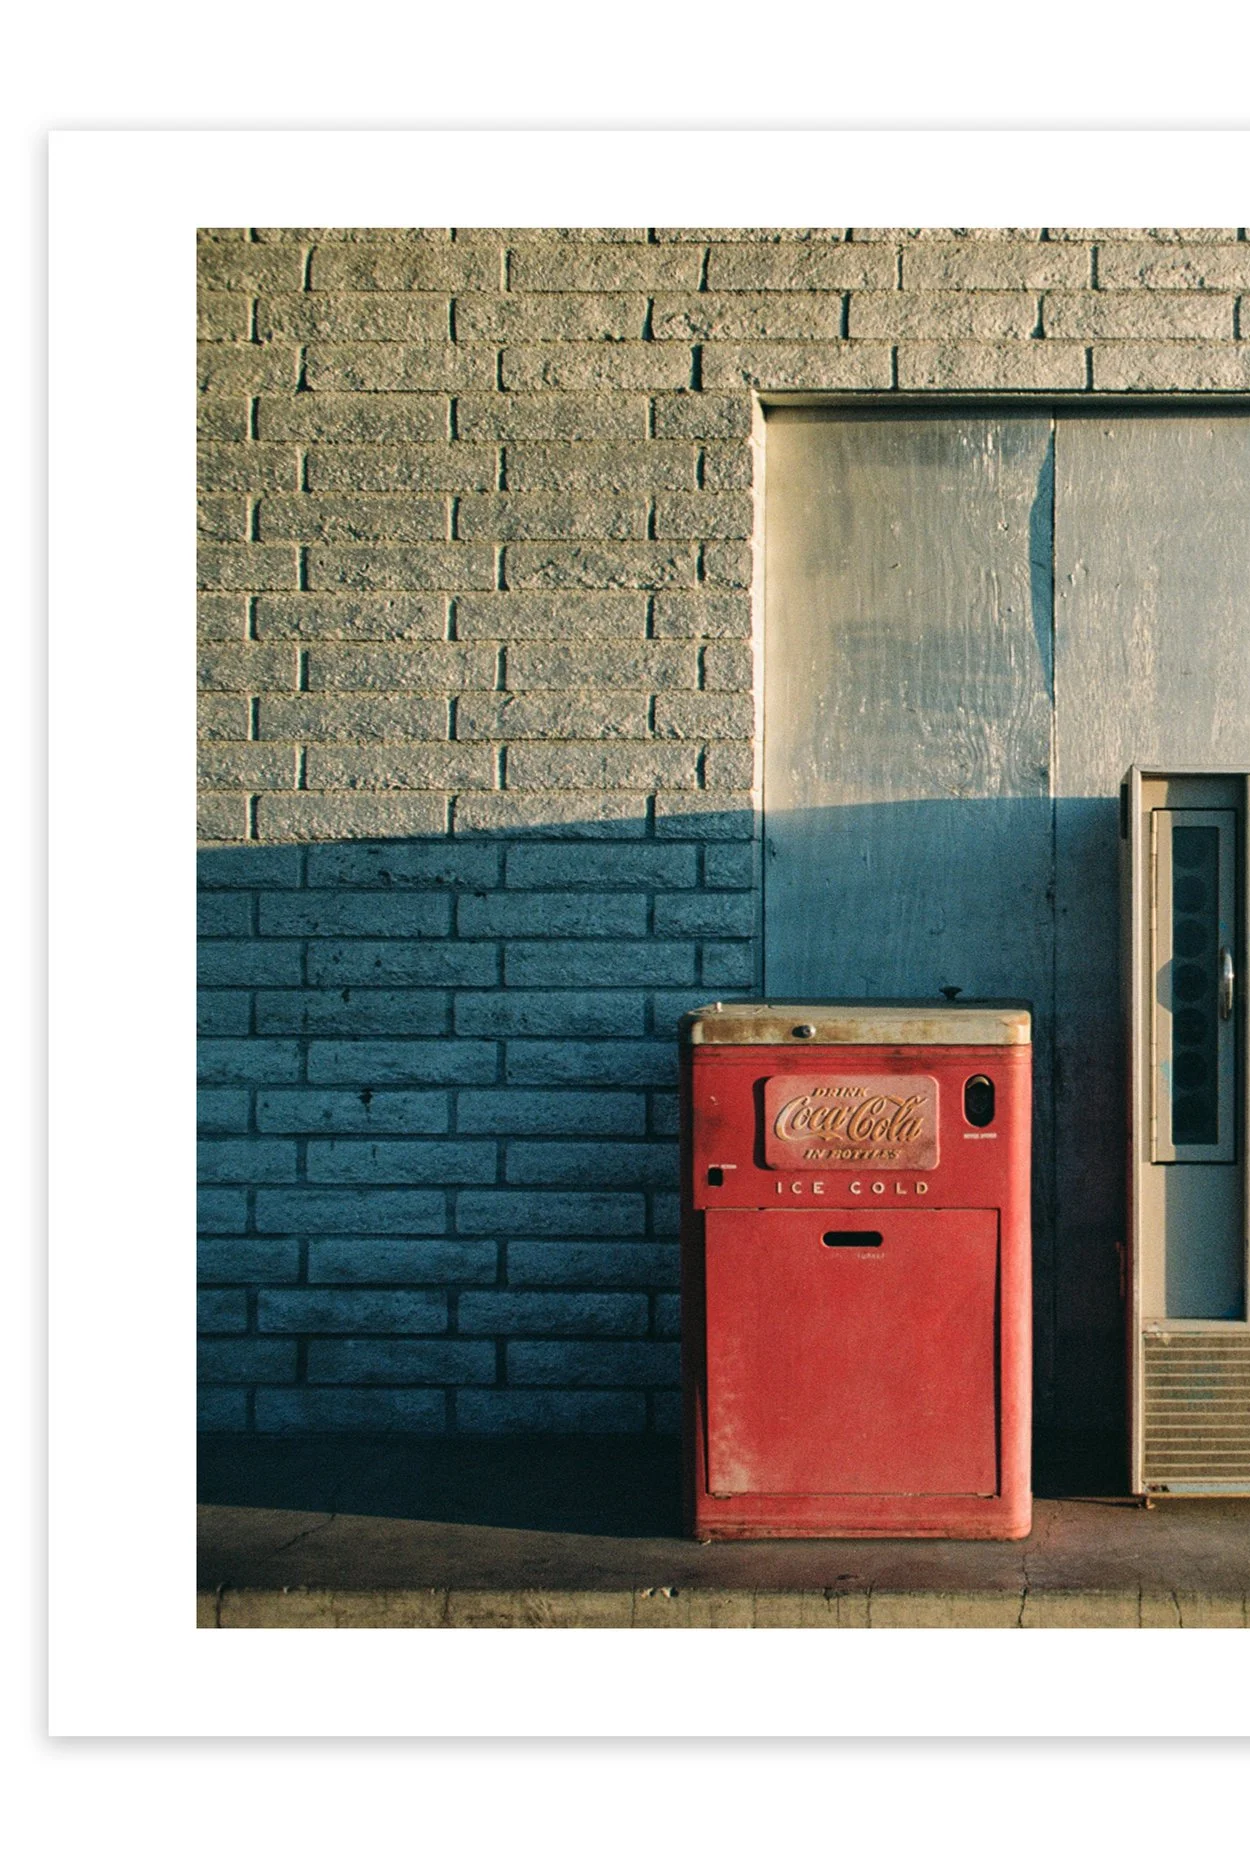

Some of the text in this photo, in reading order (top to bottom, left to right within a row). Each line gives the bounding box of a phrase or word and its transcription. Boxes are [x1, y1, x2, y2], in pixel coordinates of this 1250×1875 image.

[812, 1087, 870, 1098] DRINK
[803, 1149, 901, 1160] IN BOTTLES
[776, 1181, 929, 1195] ICE COLD
